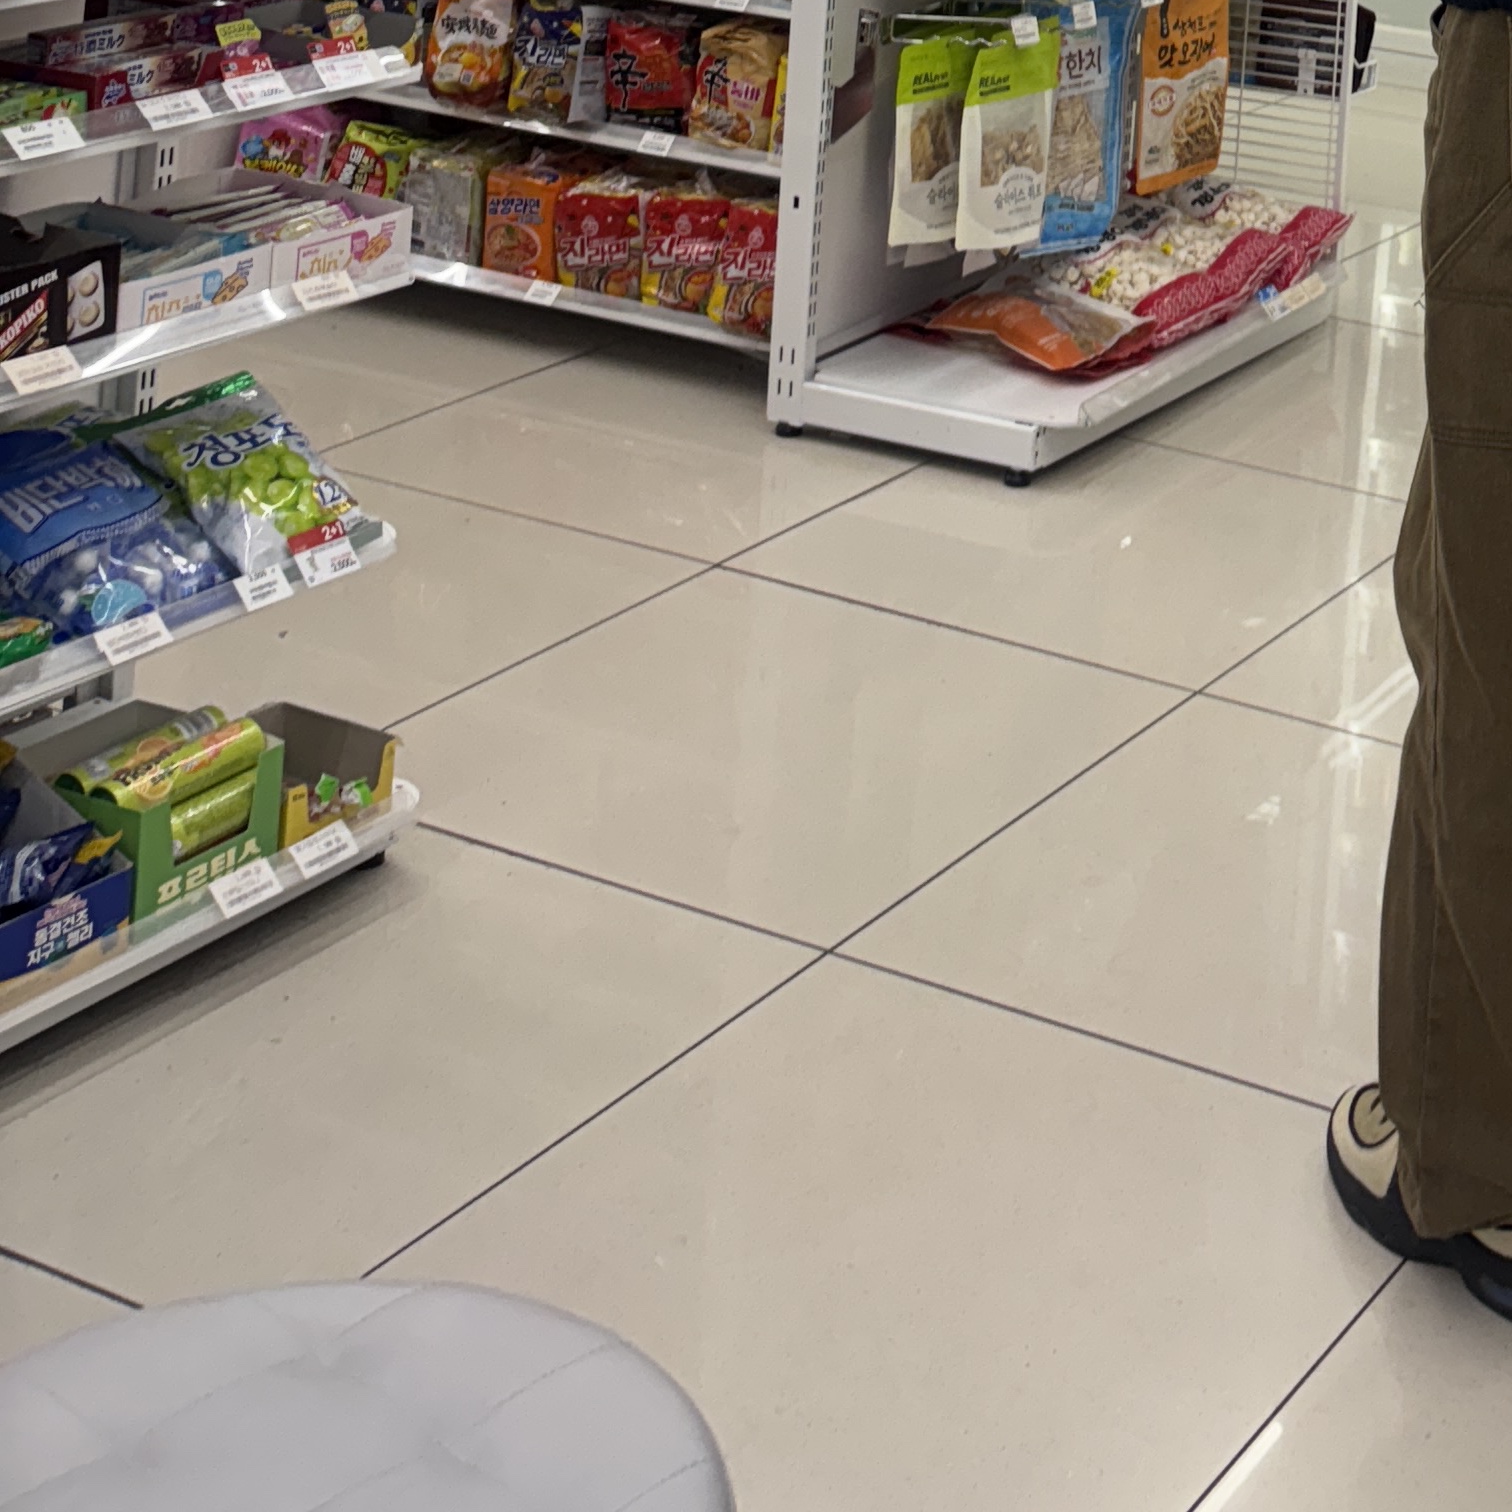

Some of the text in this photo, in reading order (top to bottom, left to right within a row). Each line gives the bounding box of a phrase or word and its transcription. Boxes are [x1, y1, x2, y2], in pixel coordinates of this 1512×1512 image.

[336, 39, 357, 54] 2+1
[1066, 46, 1102, 78] 한치
[252, 58, 273, 73] 2+1
[609, 48, 648, 111] 辛
[704, 56, 730, 105] 辛
[488, 197, 541, 216] 삼양라면
[558, 235, 631, 272] 진라면
[642, 234, 717, 272] 진라면
[0, 269, 59, 305] ISTER PACK
[0, 296, 46, 348] KOPIKO
[321, 521, 346, 540] 2+1
[27, 942, 55, 967] 지구
